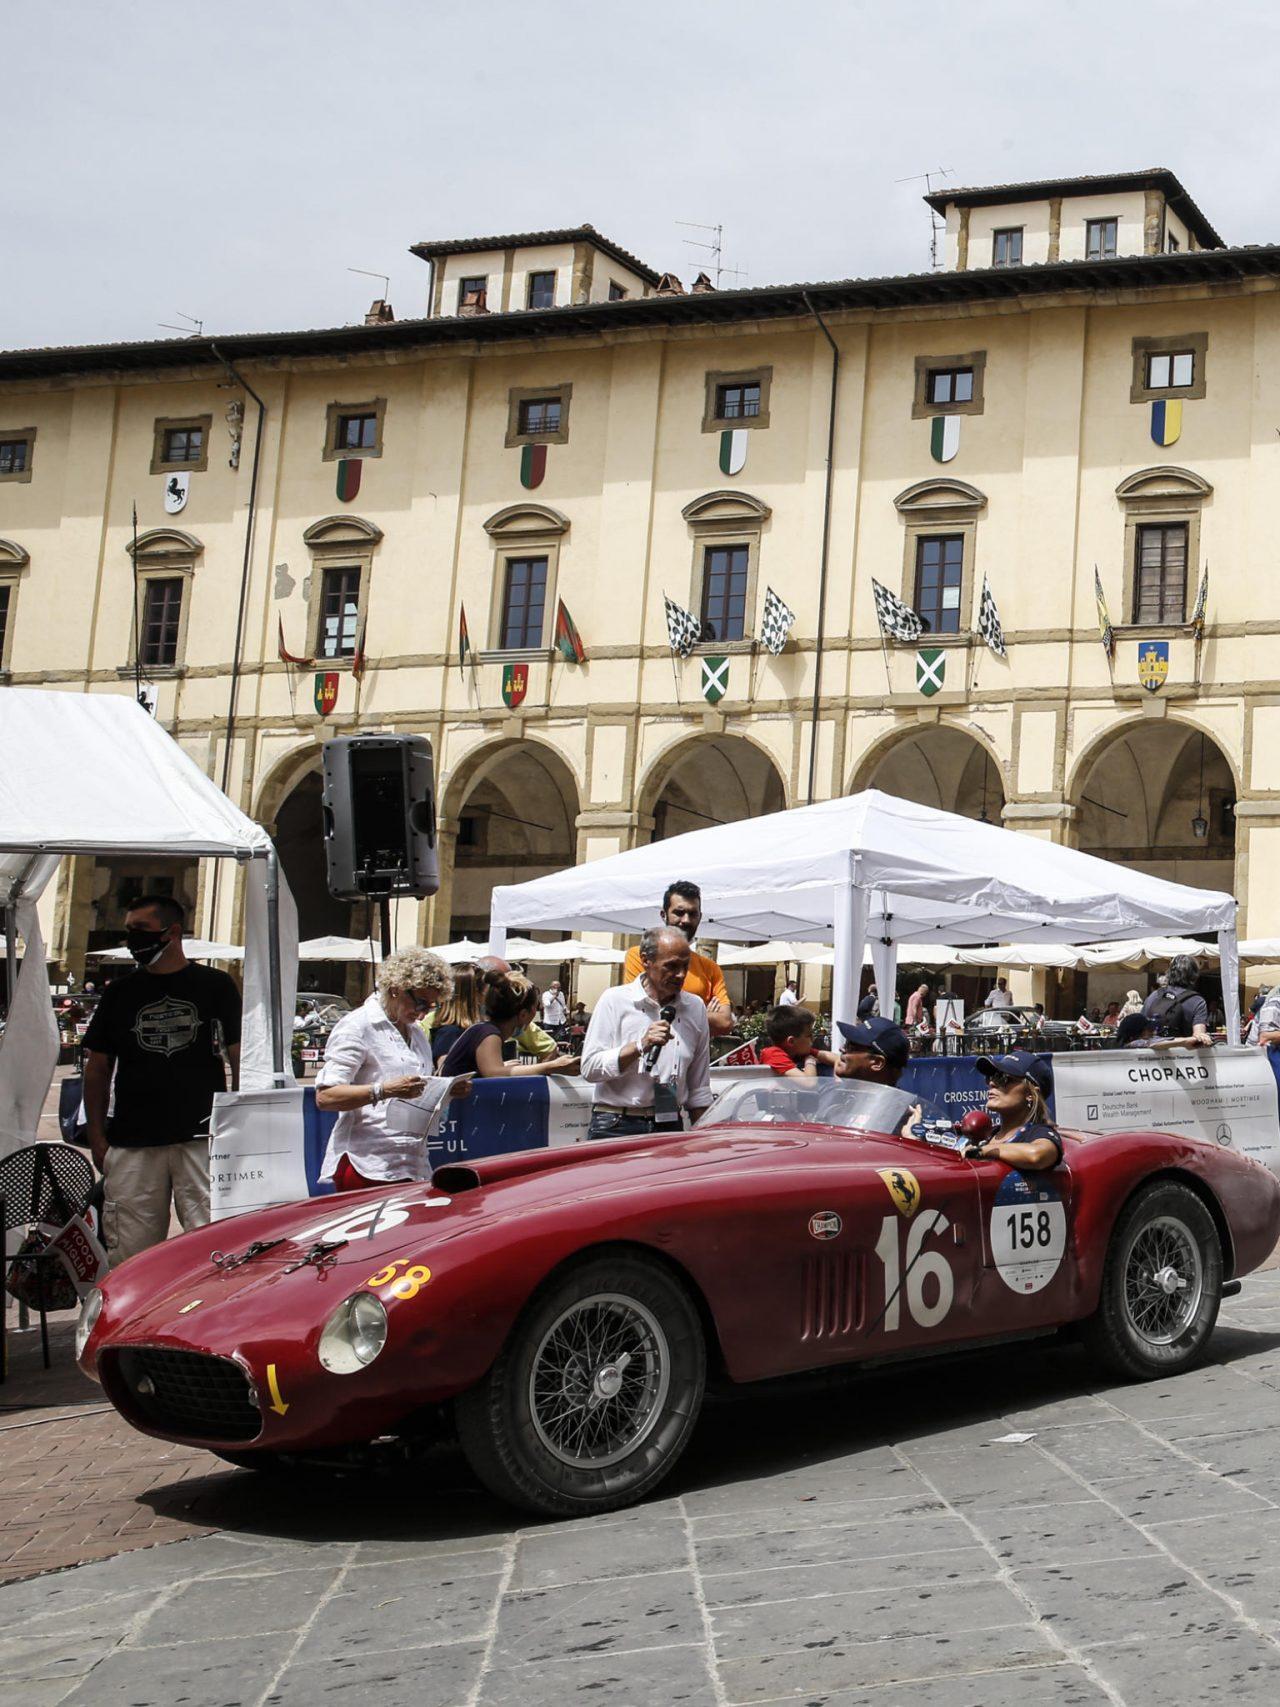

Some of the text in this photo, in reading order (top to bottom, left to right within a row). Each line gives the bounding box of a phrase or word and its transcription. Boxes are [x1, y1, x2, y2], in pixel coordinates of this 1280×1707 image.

[1128, 1066, 1209, 1083] CHOPARD
[72, 1230, 95, 1266] 1000
[1007, 1210, 1051, 1250] 158
[59, 1237, 87, 1278] MIGLIA
[875, 1209, 954, 1332] 16
